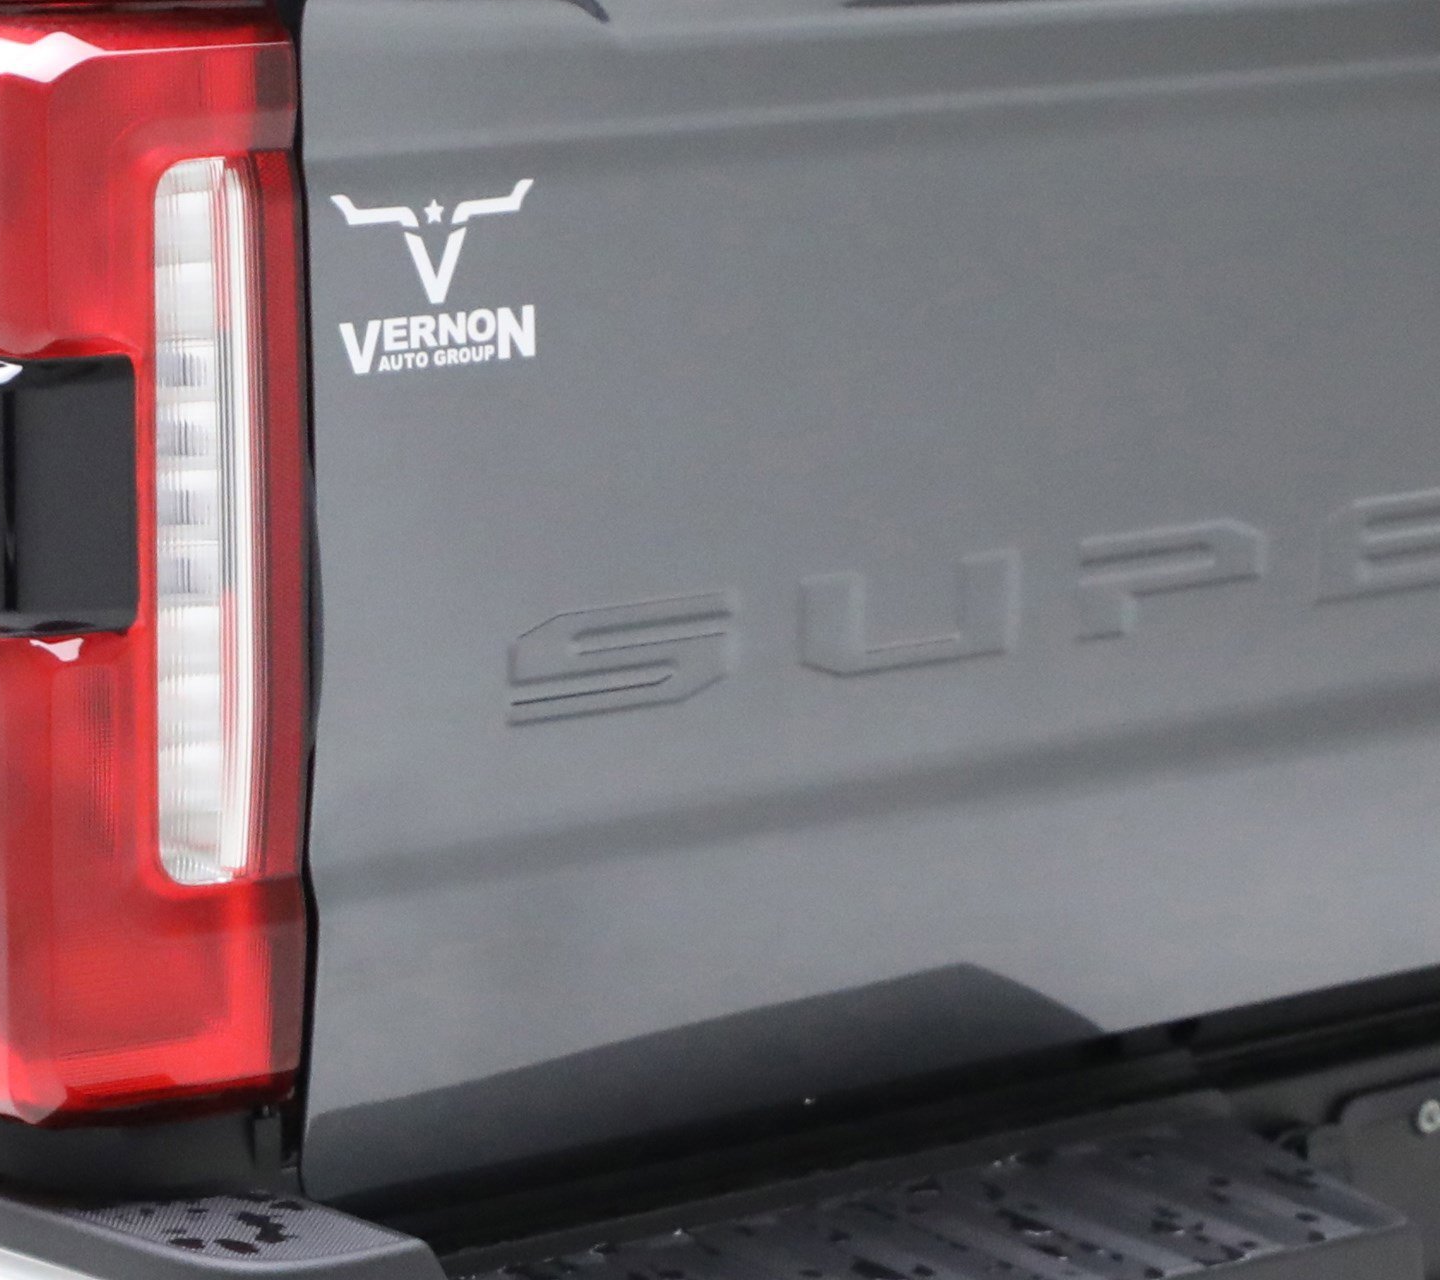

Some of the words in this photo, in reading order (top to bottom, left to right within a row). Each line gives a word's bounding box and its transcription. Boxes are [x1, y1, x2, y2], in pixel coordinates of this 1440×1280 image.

[338, 304, 536, 374] VERNON
[378, 349, 430, 372] AUTO
[433, 344, 496, 367] GROUP
